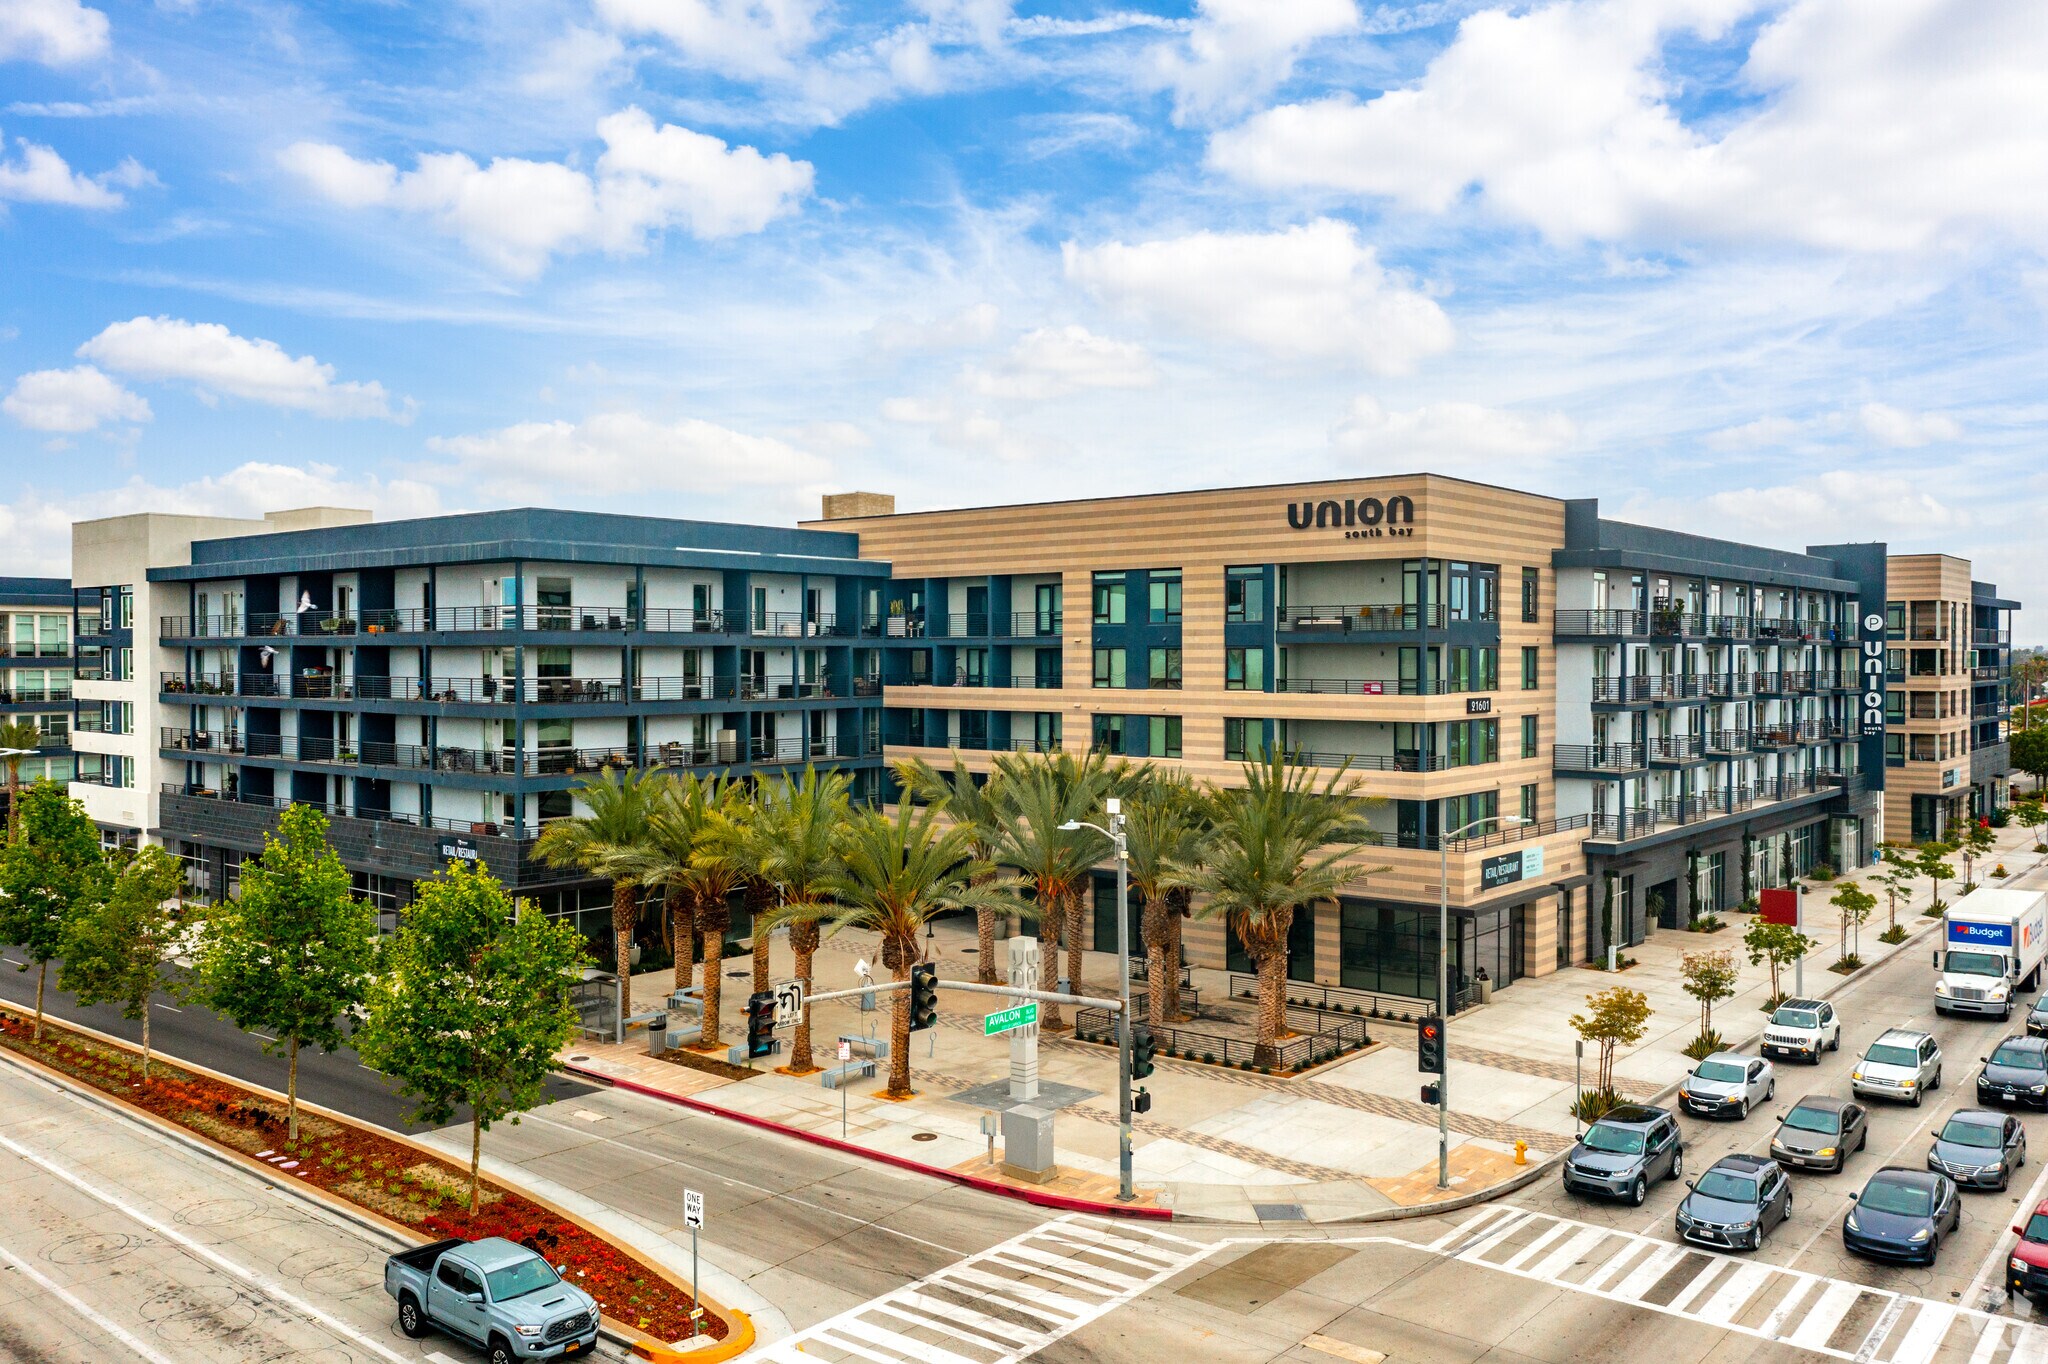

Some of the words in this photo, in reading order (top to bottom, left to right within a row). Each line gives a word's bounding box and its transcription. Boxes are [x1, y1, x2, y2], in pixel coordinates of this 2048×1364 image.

[1345, 528, 1382, 538] south
[1389, 527, 1413, 537] bay
[1969, 926, 2004, 938] Budget
[989, 1010, 1021, 1027] AVALON
[686, 1192, 700, 1205] ONE
[686, 1203, 701, 1215] WAY
